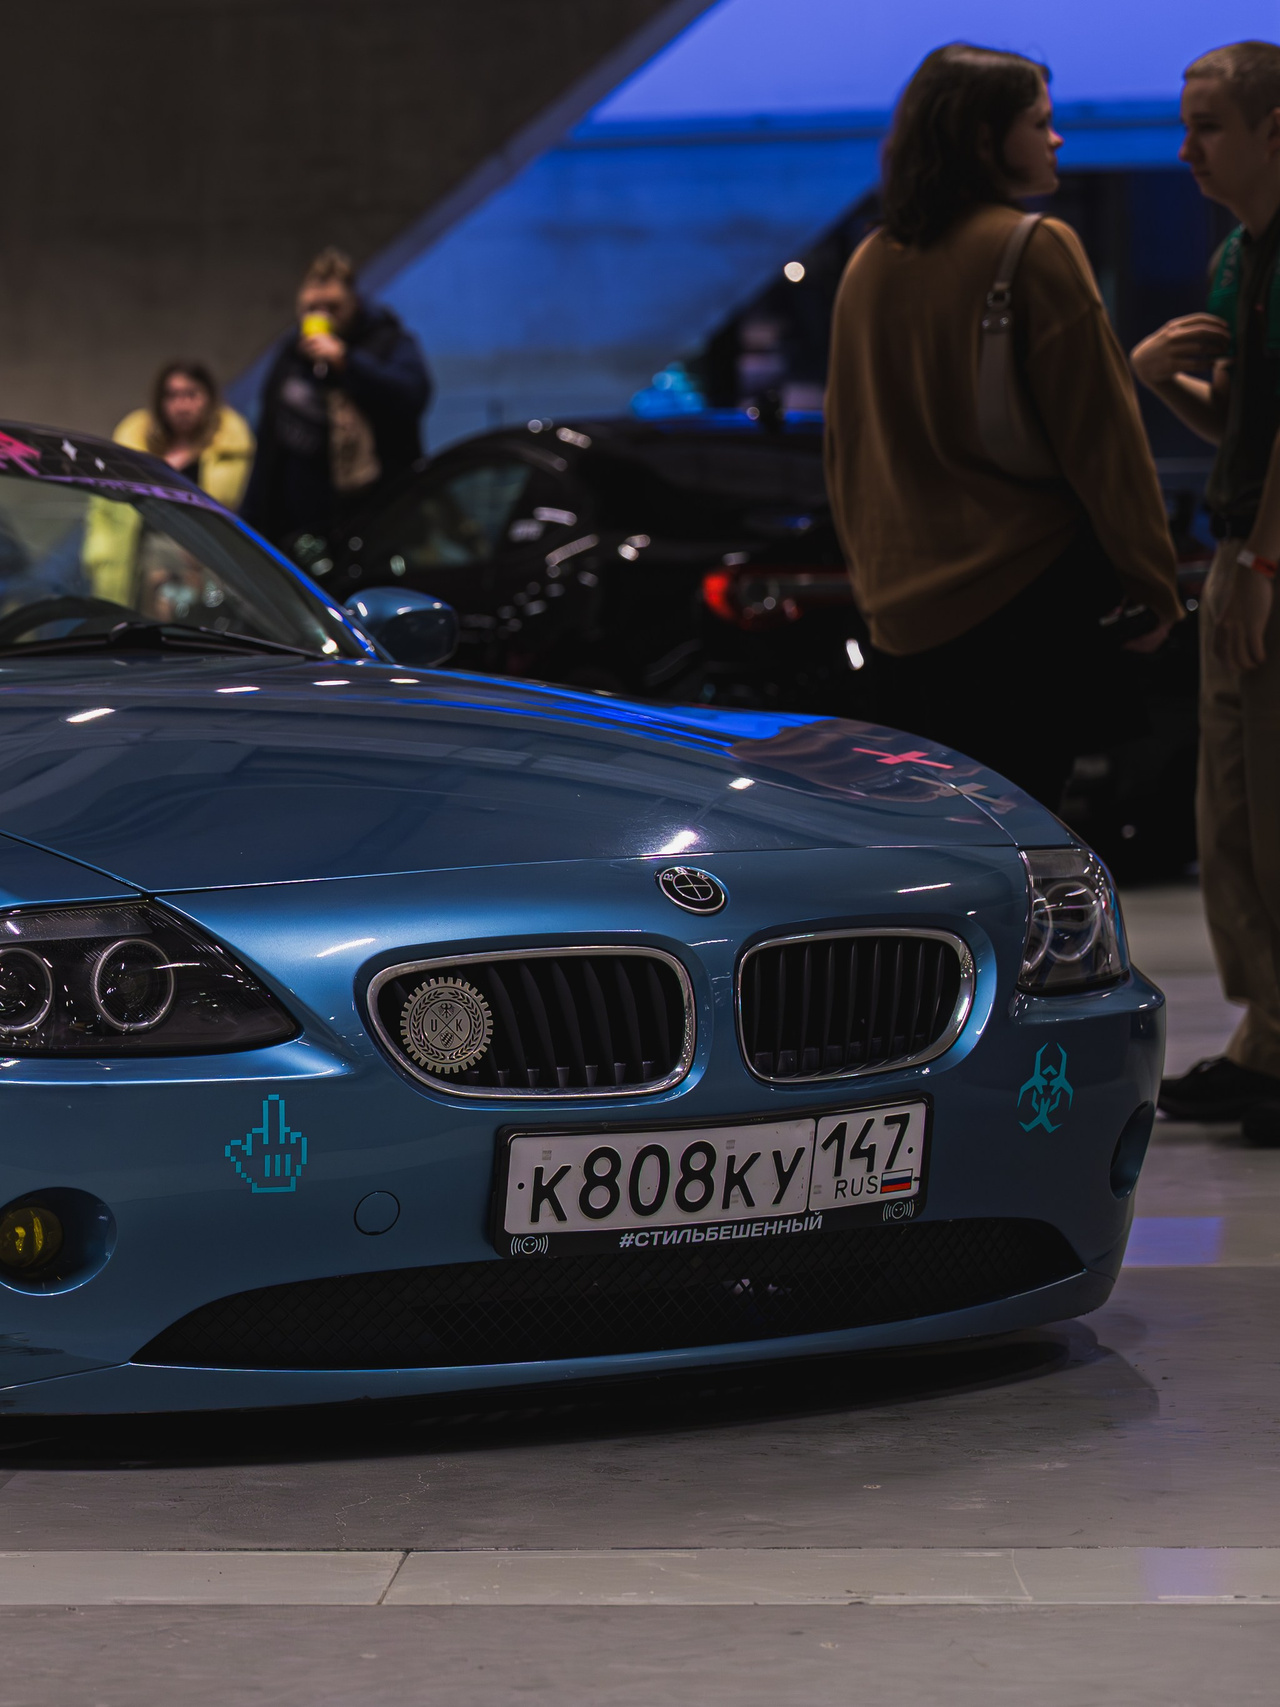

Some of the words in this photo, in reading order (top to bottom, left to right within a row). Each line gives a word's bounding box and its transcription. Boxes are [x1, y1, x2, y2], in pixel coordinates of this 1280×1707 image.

[430, 1019, 438, 1032] U
[455, 1019, 462, 1031] K
[530, 1140, 806, 1223] К808КУ
[821, 1112, 910, 1177] 147
[834, 1175, 878, 1199] RUS
[619, 1211, 823, 1248] #СТИЛЬБЕШЕННЫЙ
